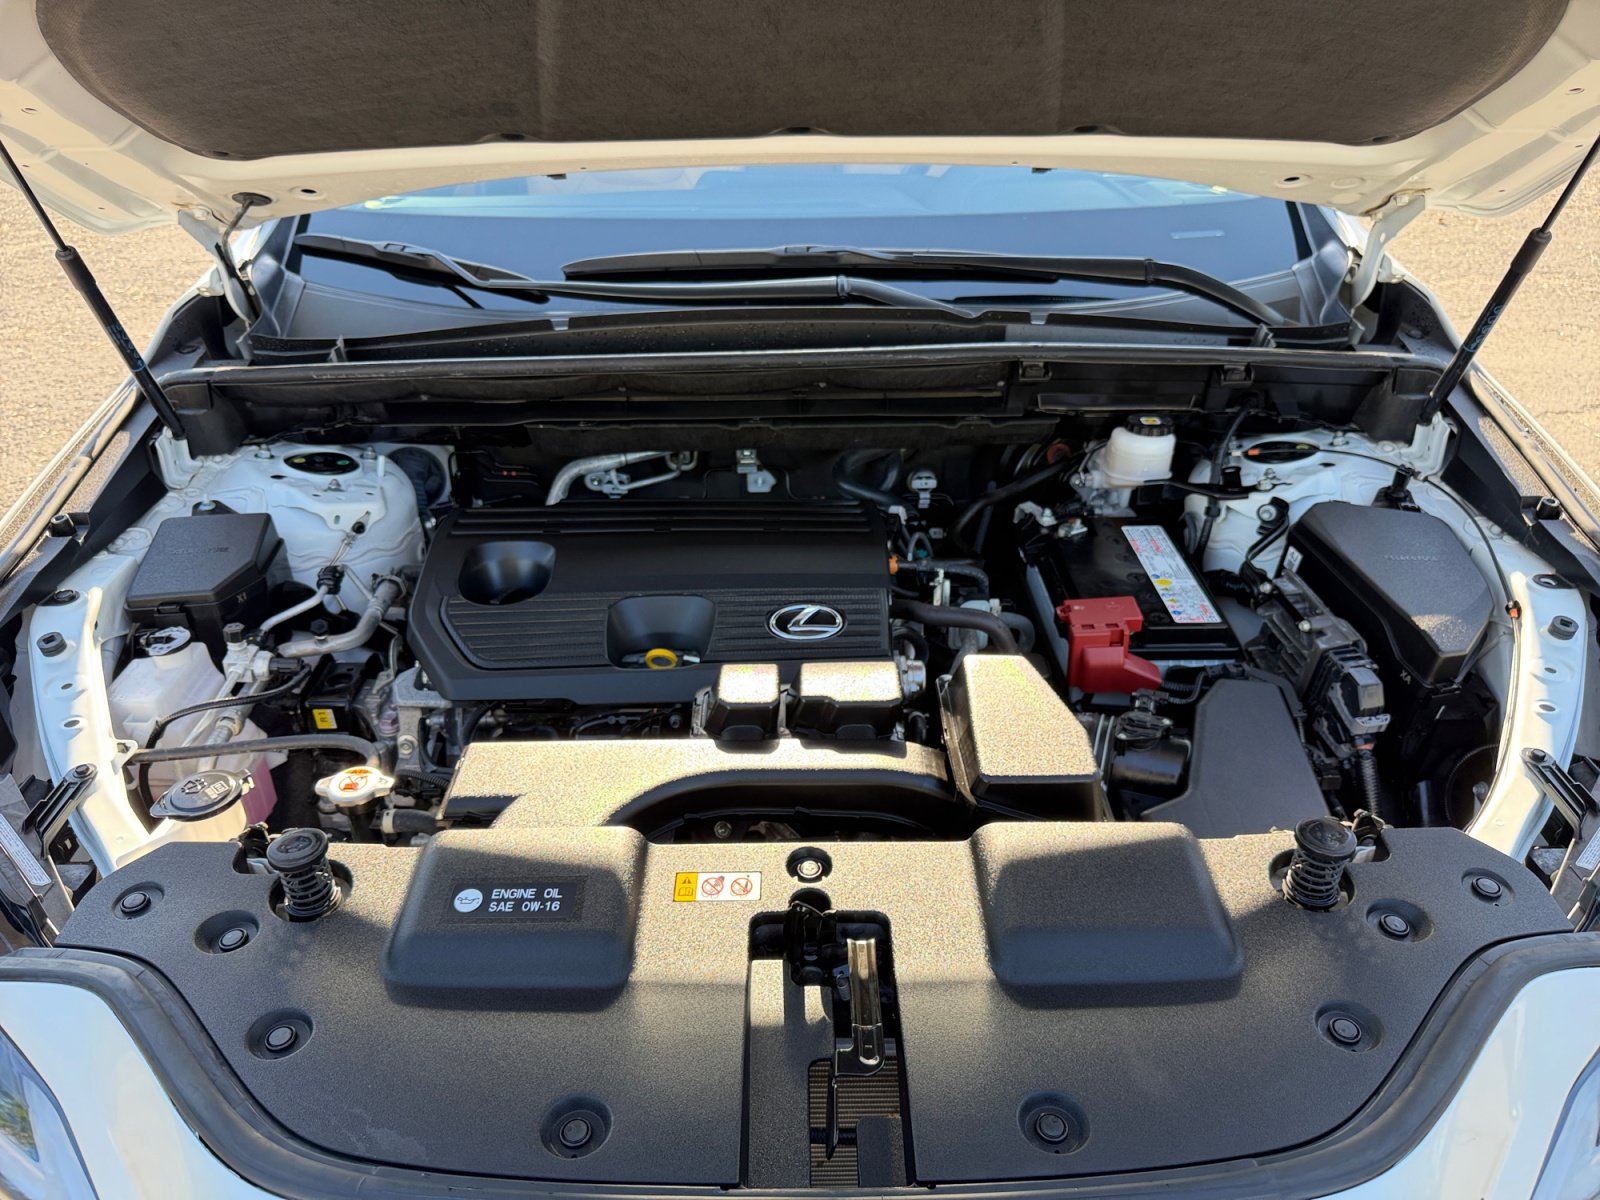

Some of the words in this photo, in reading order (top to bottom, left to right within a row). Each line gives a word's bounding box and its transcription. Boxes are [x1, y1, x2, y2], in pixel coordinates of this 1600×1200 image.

[491, 888, 536, 899] ENGINE
[544, 888, 562, 899] OIL
[488, 901, 514, 912] SAE
[521, 901, 560, 912] 0W-16
